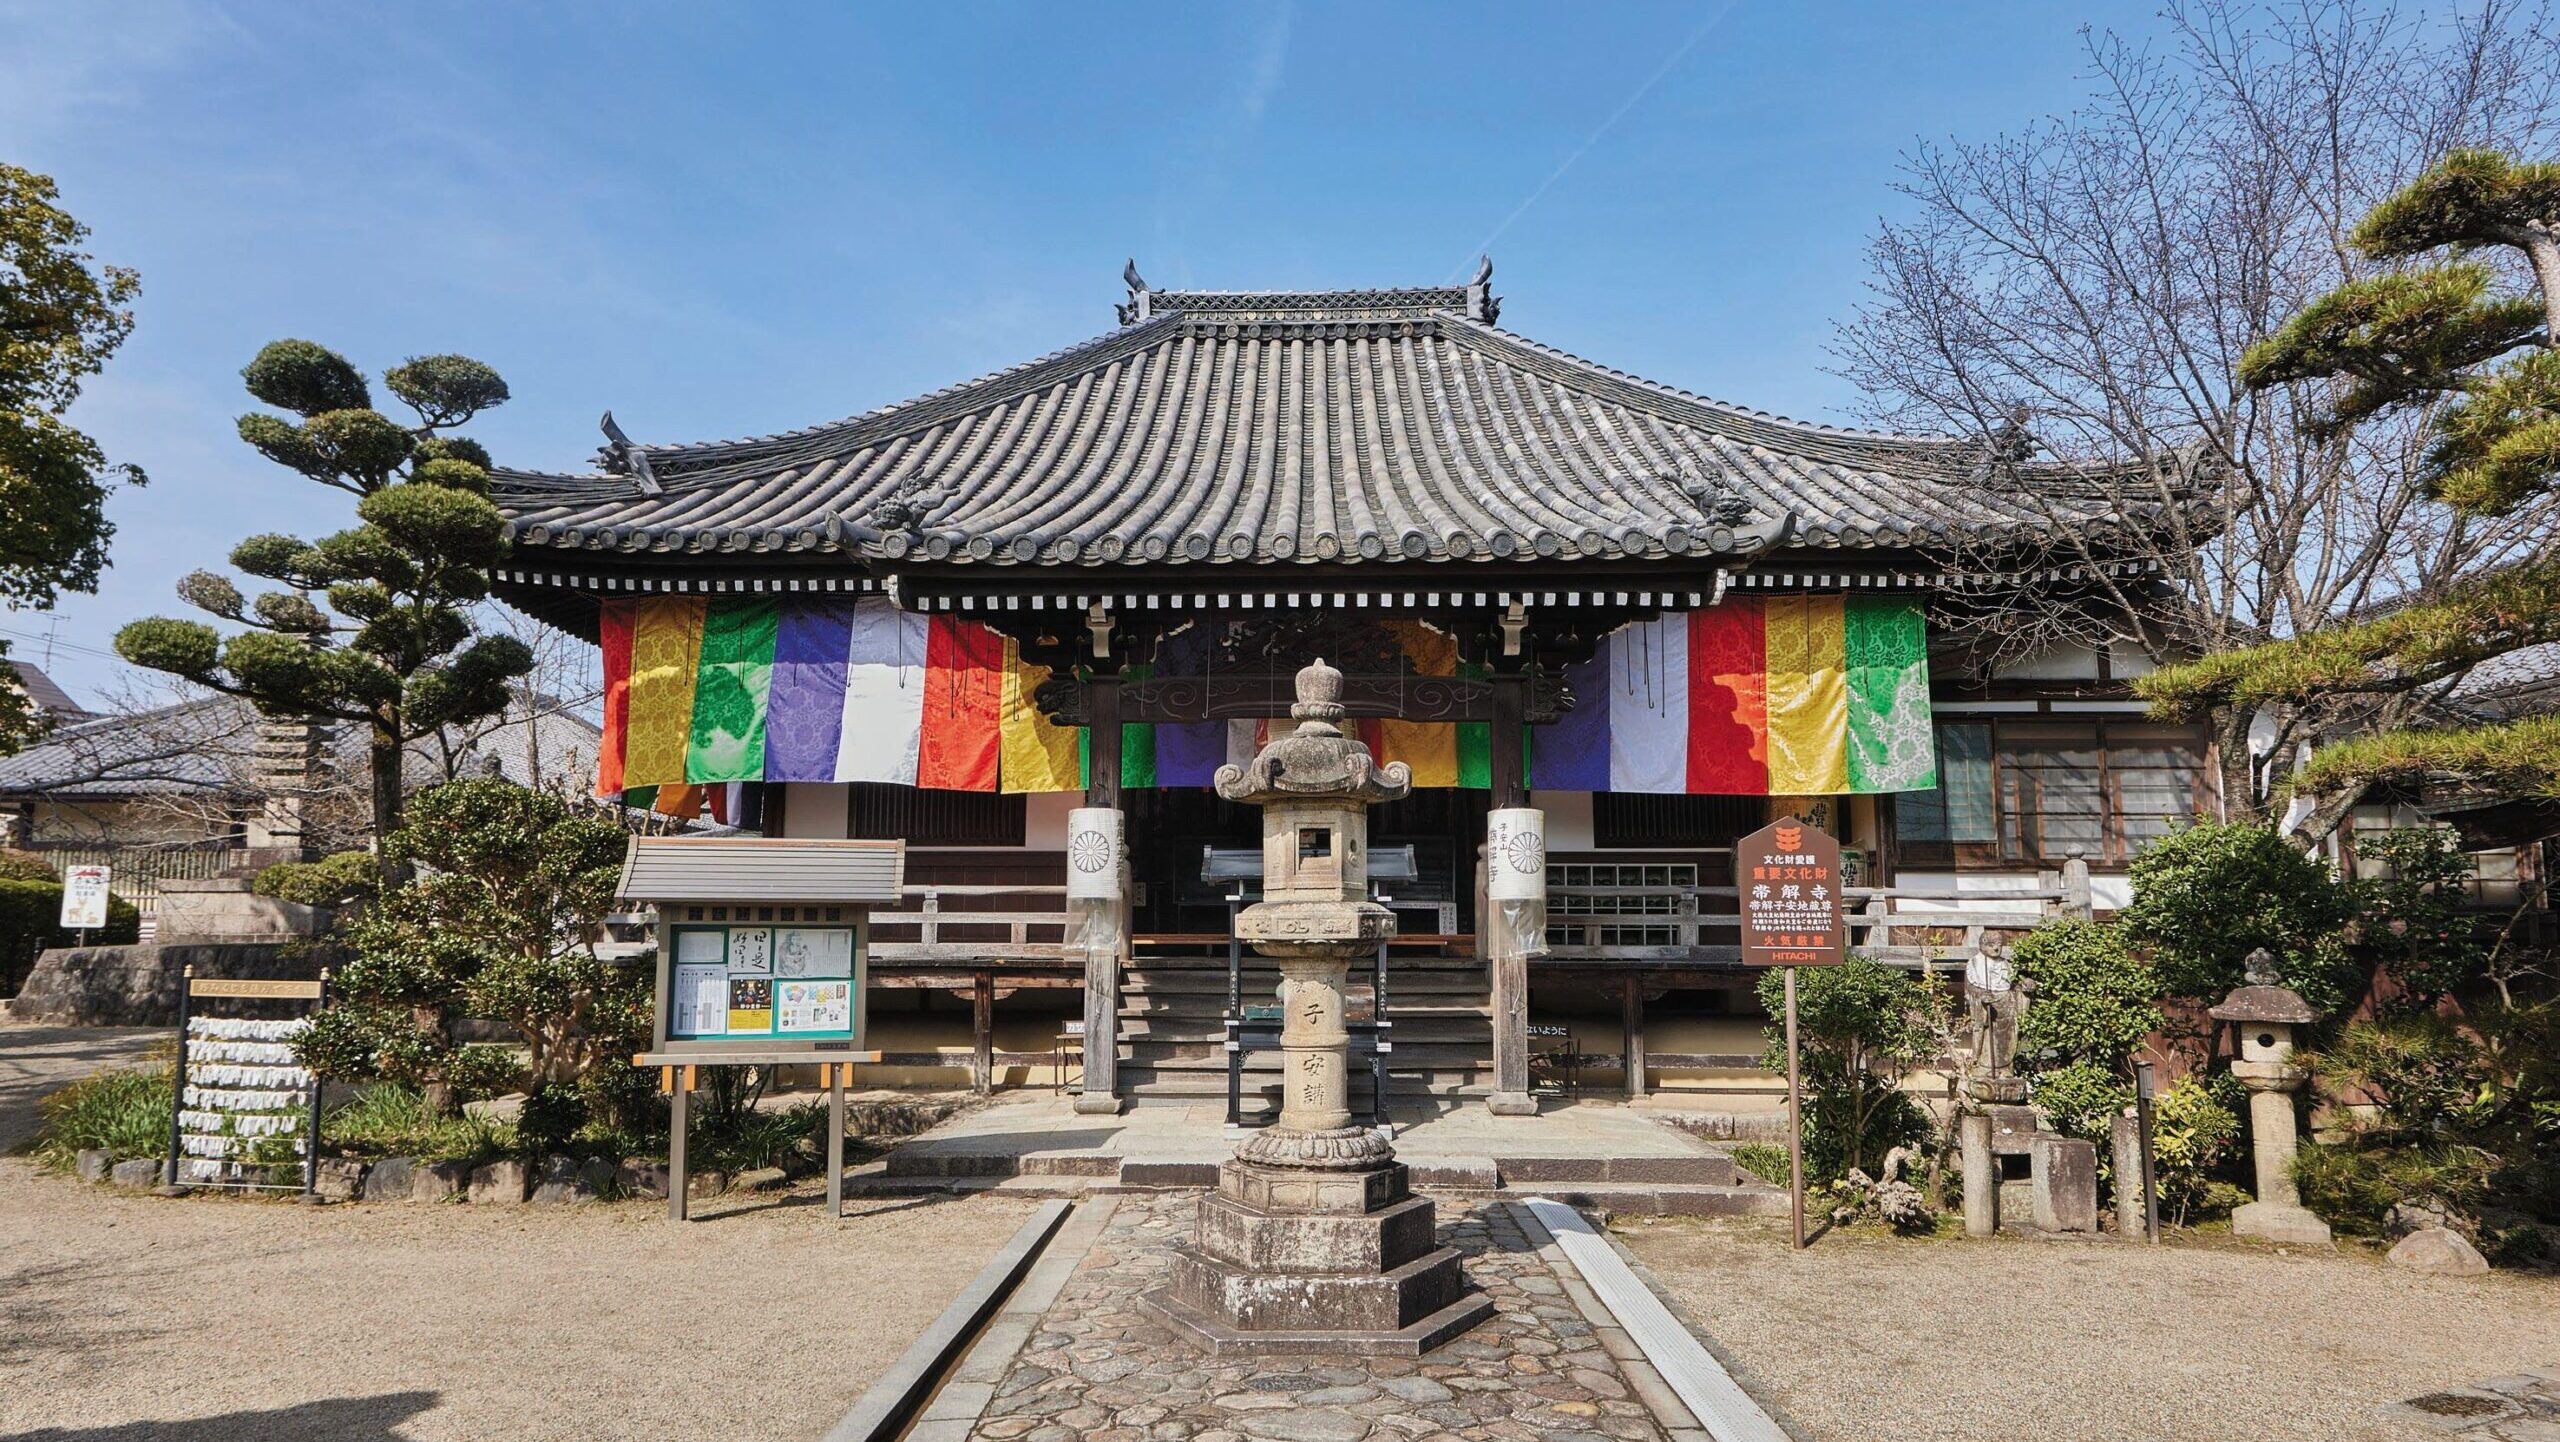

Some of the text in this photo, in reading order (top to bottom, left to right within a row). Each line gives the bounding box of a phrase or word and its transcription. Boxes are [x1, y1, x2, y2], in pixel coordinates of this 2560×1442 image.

[1763, 855, 1816, 865] 文化財愛護
[1753, 866, 1828, 880] 重要文化財
[1752, 884, 1829, 900] 帯解寺
[1749, 900, 1833, 911] 帯解子安地蔵尊
[1764, 935, 1825, 946] 火気厳禁
[1772, 952, 1816, 961] HITACHI
